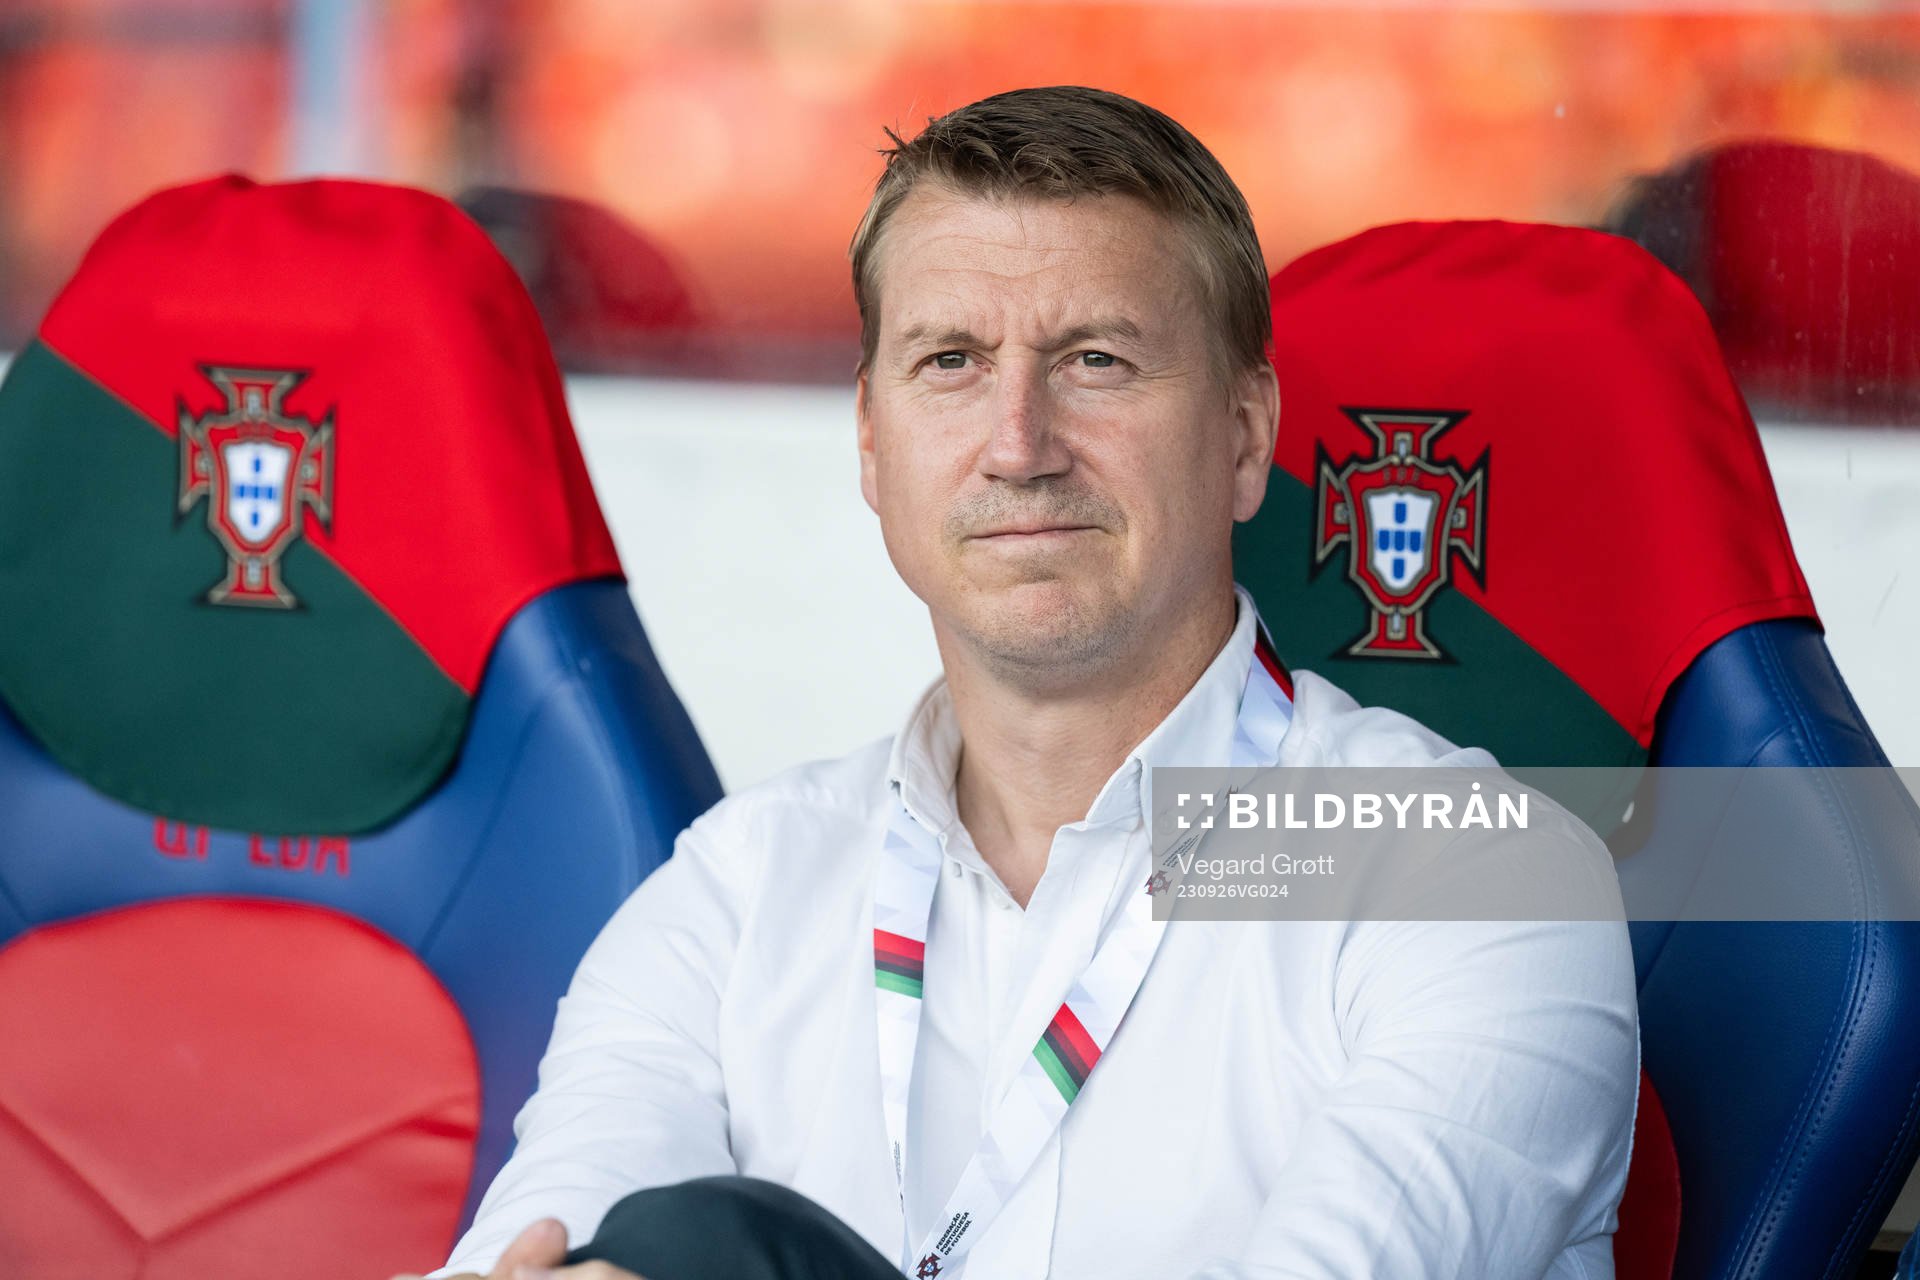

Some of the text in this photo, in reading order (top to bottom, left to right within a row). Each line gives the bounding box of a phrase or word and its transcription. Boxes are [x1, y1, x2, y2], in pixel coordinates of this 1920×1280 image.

[936, 1212, 961, 1250] FEDERAÇÃO
[940, 1212, 970, 1253] PORTUGUESA
[944, 1220, 973, 1256] DE FUTEBOL
